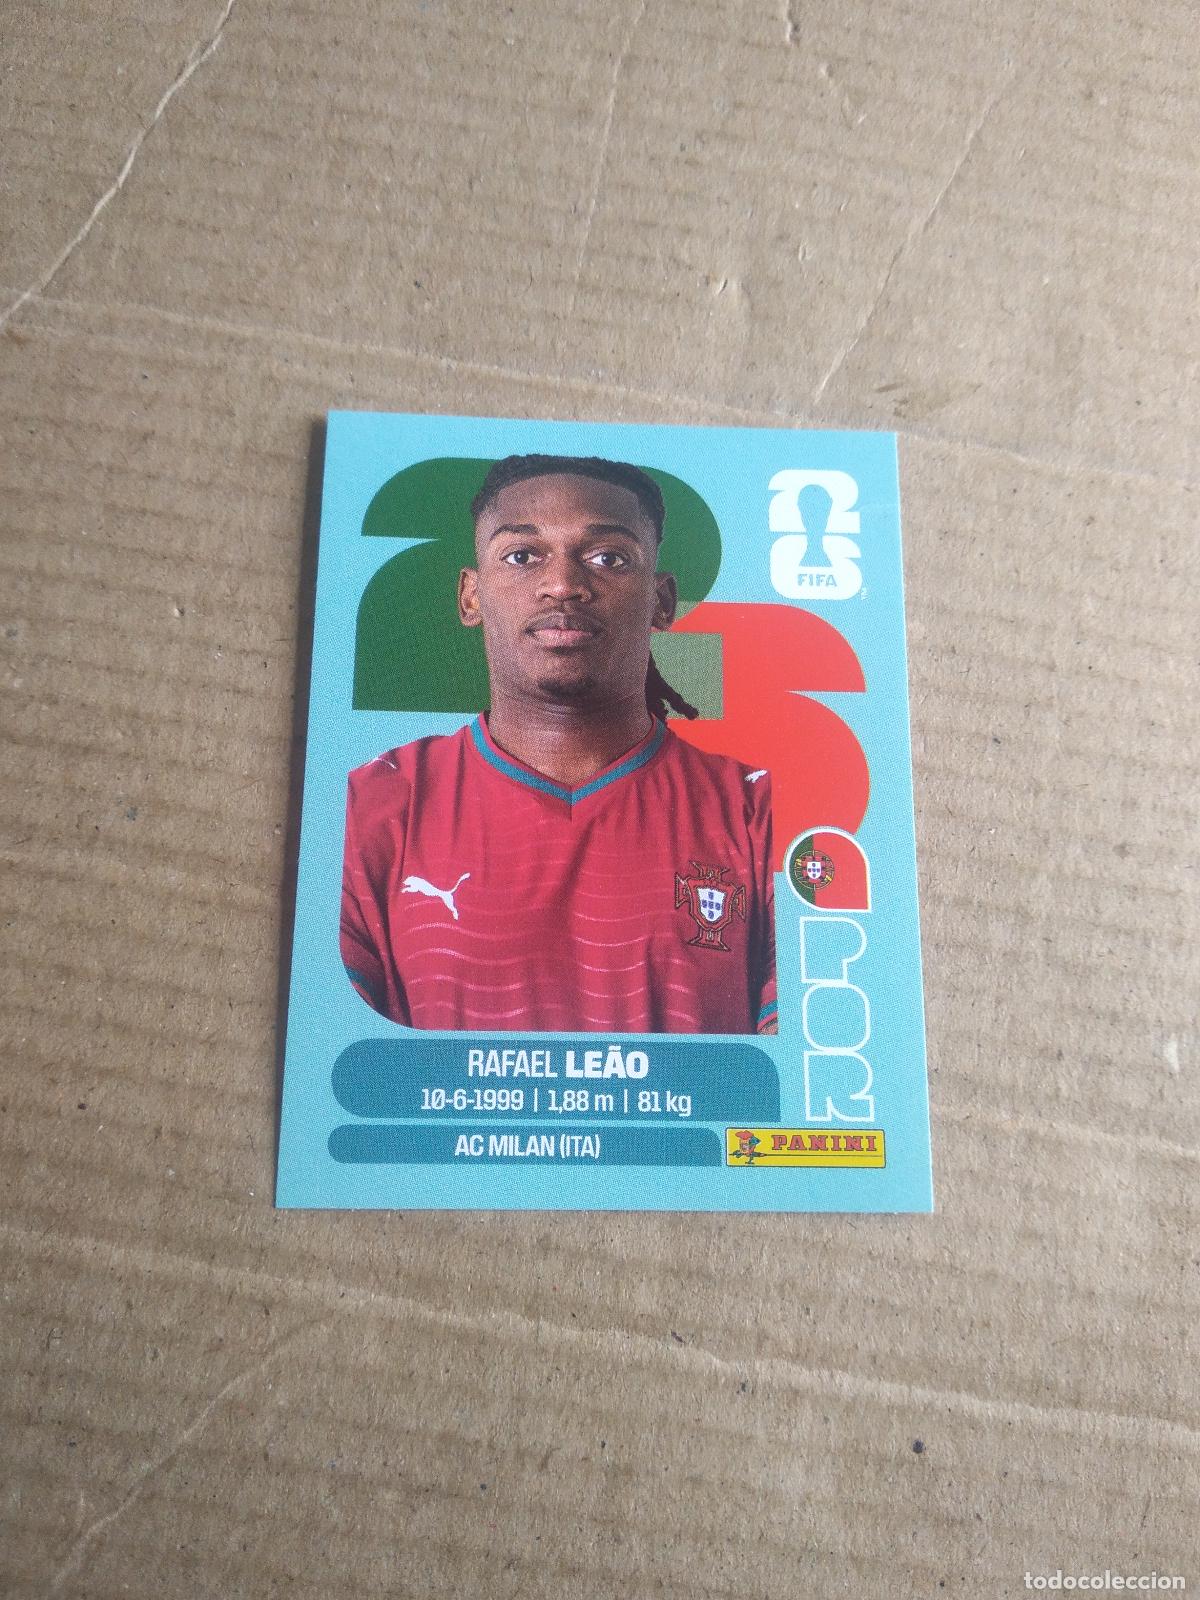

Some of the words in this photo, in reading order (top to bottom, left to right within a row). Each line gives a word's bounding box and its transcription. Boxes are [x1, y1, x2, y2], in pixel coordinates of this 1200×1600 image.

[797, 573, 837, 587] FIFA
[468, 1049, 558, 1077] RAFAEL
[565, 1045, 649, 1079] LEÃO
[420, 1087, 524, 1110] 10-6-1999
[547, 1089, 590, 1113] 1,88
[594, 1092, 614, 1111] m
[637, 1090, 660, 1112] 81
[665, 1090, 692, 1117] kg
[454, 1134, 484, 1156] AC
[488, 1135, 555, 1158] MILAN
[559, 1134, 602, 1159] (ITA)
[771, 1133, 878, 1152] PANINI
